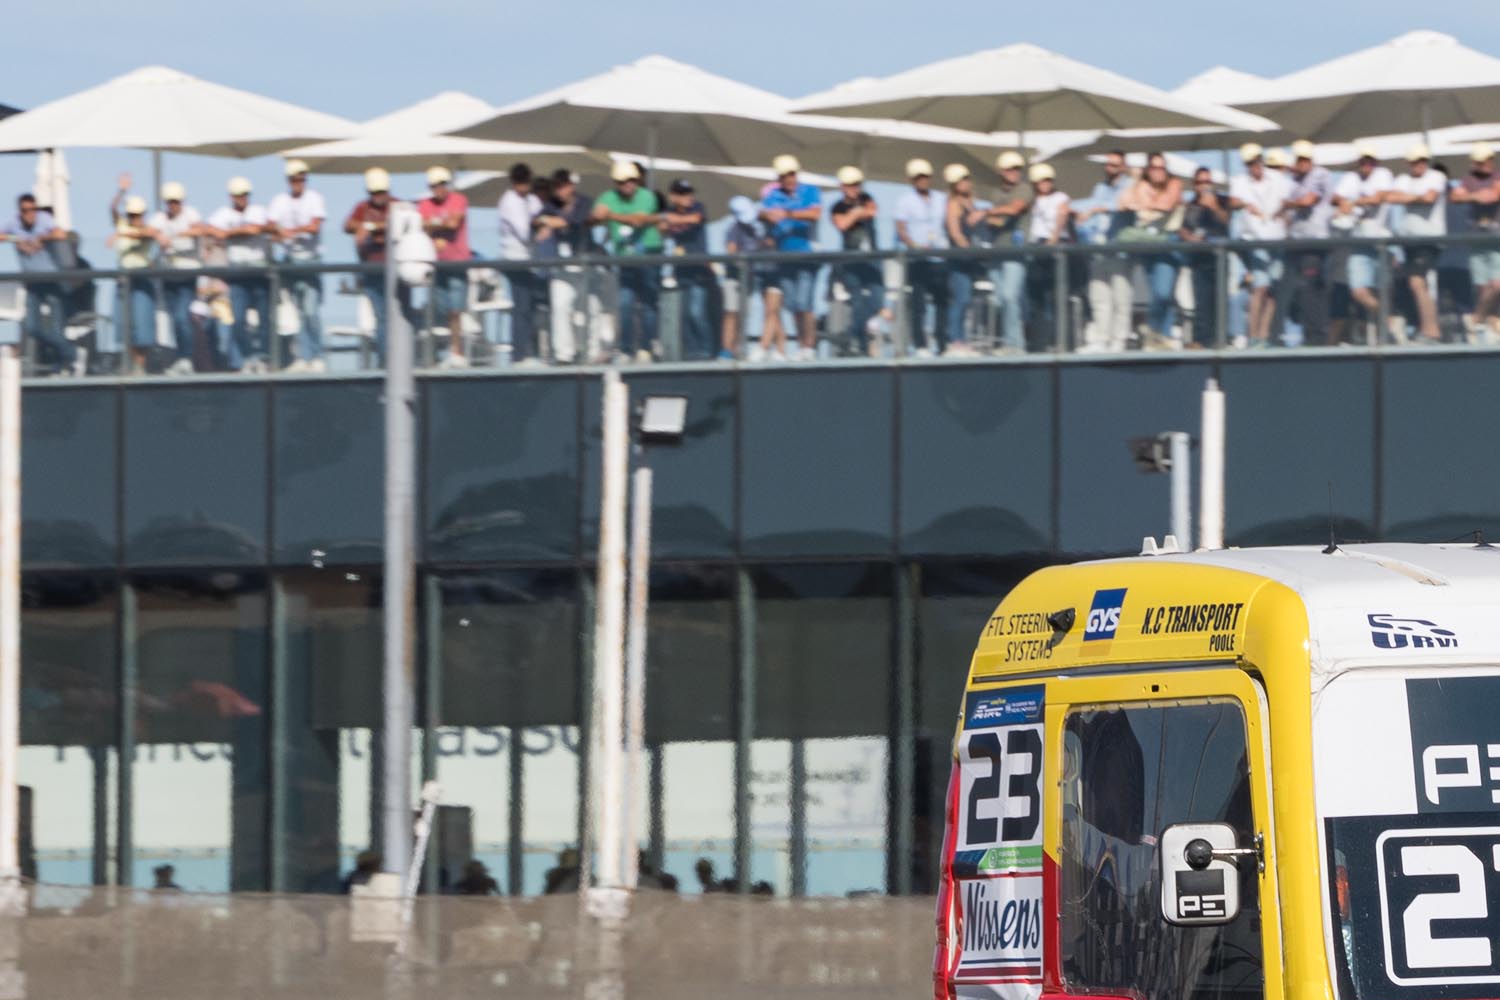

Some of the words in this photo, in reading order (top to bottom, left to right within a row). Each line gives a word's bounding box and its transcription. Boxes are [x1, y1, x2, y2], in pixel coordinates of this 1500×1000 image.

[987, 616, 1005, 637] FTL
[1007, 612, 1057, 636] STEERIN
[1086, 606, 1121, 633] GYS
[1141, 607, 1165, 635] K.C
[1165, 603, 1244, 633] TRANSPORT
[1004, 638, 1056, 662] SYSTEMS
[1209, 634, 1235, 651] POOLE
[965, 728, 1042, 845] 23
[964, 882, 1040, 951] Nissens
[1179, 894, 1226, 917] PE
